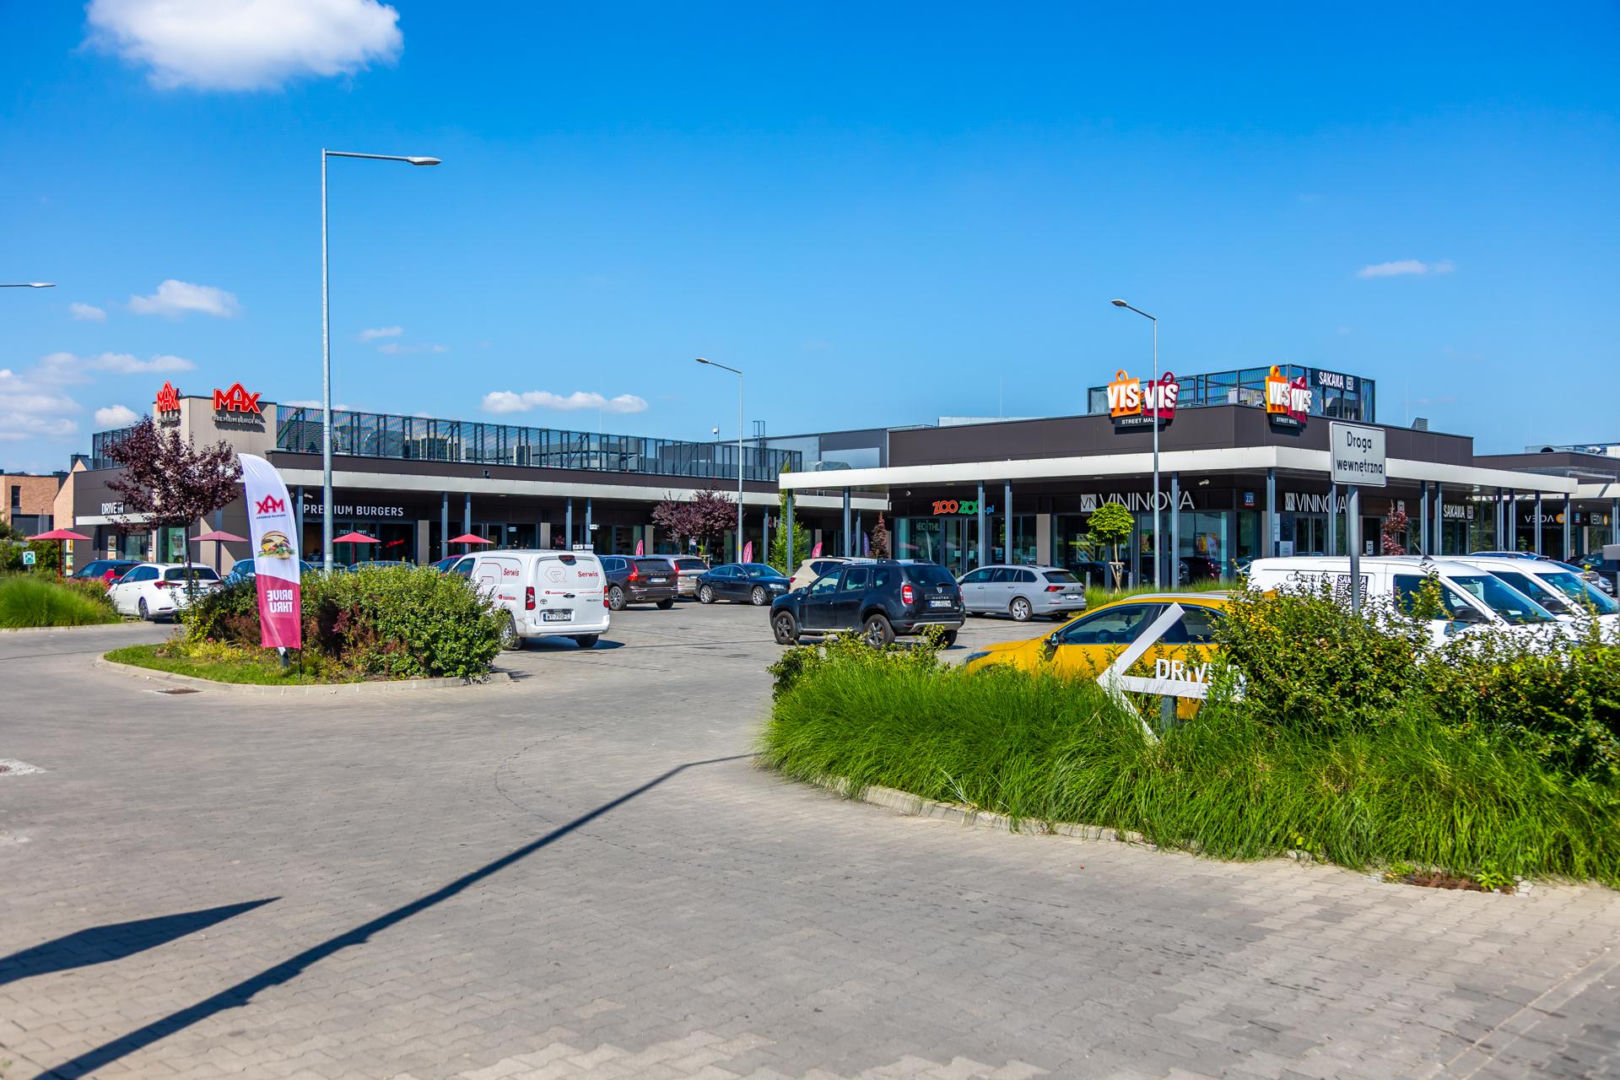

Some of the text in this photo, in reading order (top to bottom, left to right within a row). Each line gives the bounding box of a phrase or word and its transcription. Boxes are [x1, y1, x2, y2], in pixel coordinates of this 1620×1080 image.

[156, 380, 180, 413] MAX
[212, 381, 263, 414] MAX
[1107, 382, 1179, 409] VIS VIS
[1269, 380, 1313, 414] VIS VIS
[1121, 417, 1142, 425] STREET
[1346, 430, 1372, 453] Droga
[1336, 458, 1383, 477] wewnętrzna
[303, 504, 404, 517] PREIUM BURGERS
[932, 500, 959, 515] ZOO
[1098, 490, 1196, 512] VININOVA
[503, 567, 520, 577] Serwis
[577, 570, 599, 578] Serwis
